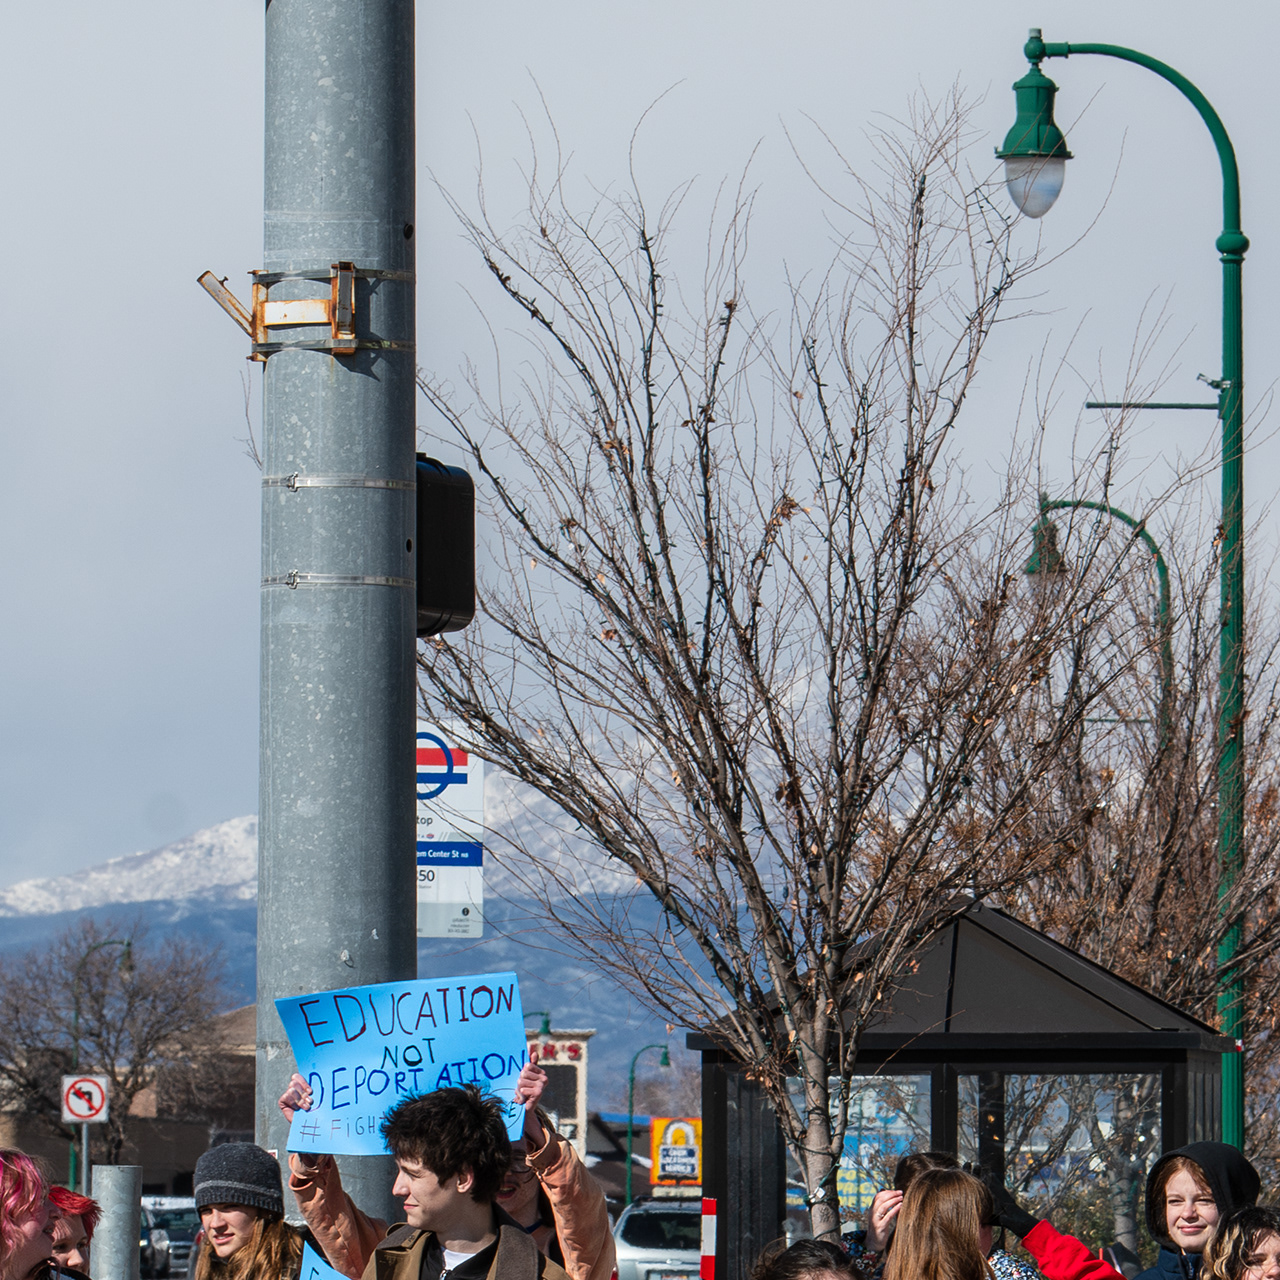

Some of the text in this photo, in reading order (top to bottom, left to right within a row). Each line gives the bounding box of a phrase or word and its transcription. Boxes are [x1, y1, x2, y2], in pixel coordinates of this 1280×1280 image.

[417, 815, 433, 826] top
[428, 849, 450, 858] Center
[452, 850, 459, 858] St
[417, 869, 435, 882] 50
[299, 984, 514, 1047] EDUCATION
[381, 1037, 435, 1069] NOT
